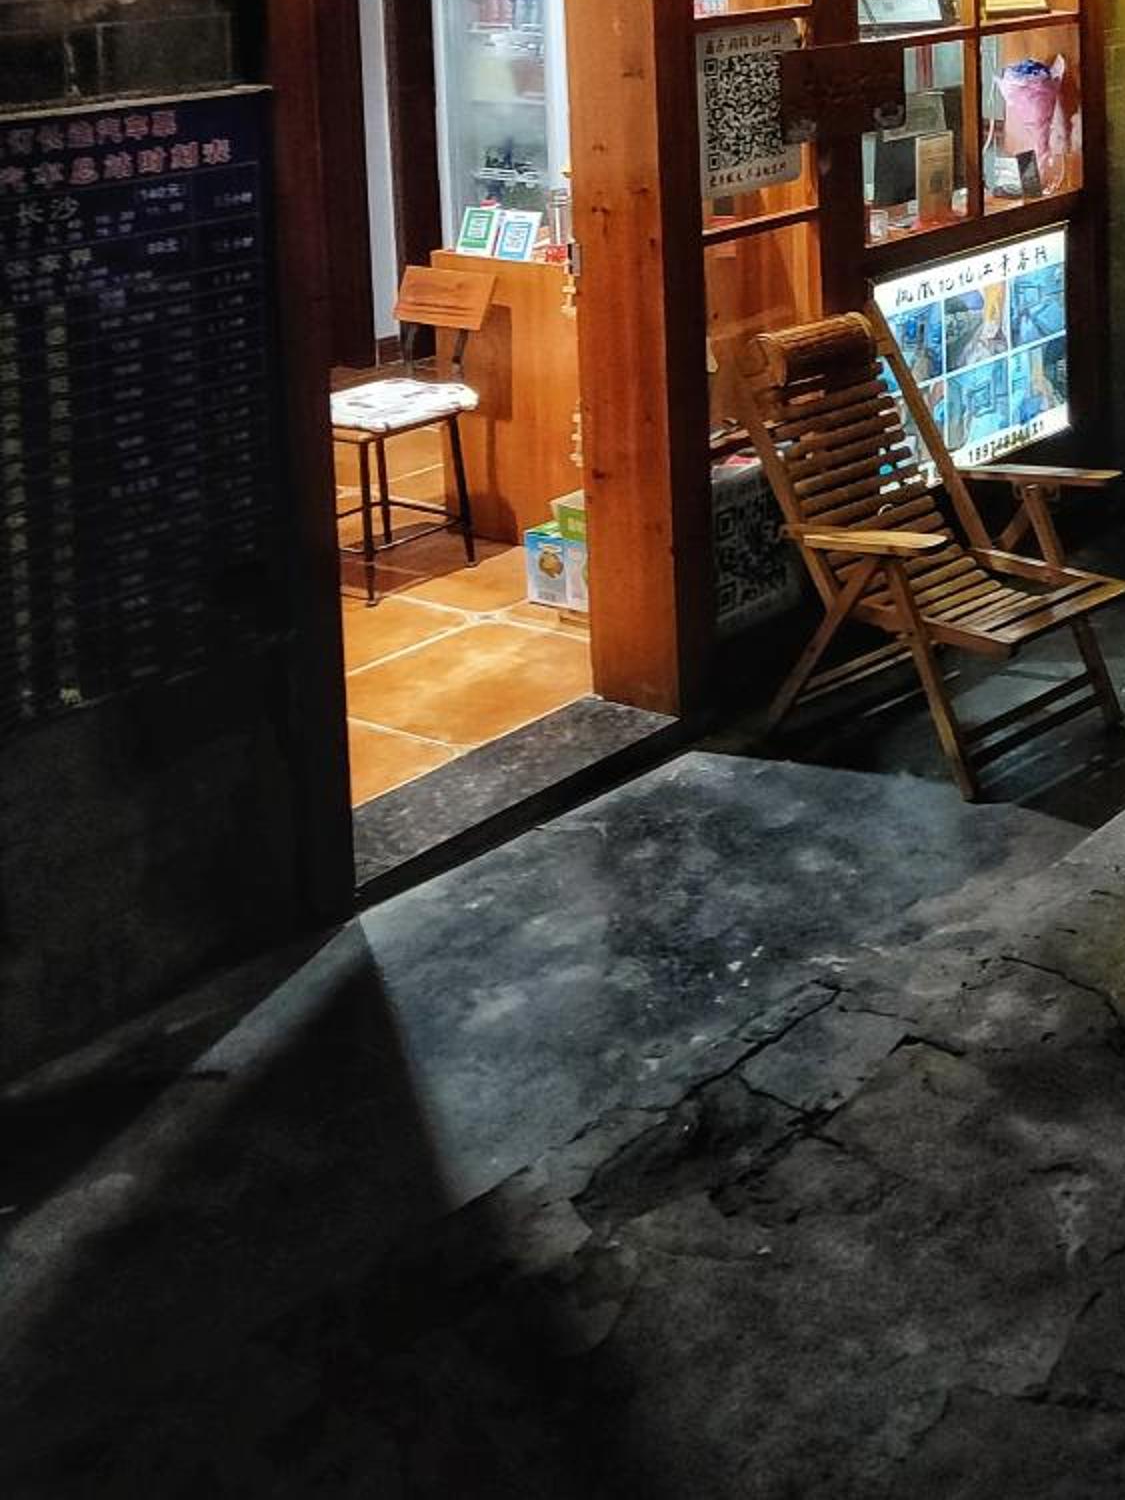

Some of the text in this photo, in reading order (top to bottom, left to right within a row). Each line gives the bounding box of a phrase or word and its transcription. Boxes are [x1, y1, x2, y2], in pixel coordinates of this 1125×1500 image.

[0, 110, 177, 158] 订长途汽车票
[16, 196, 80, 227] 长沙
